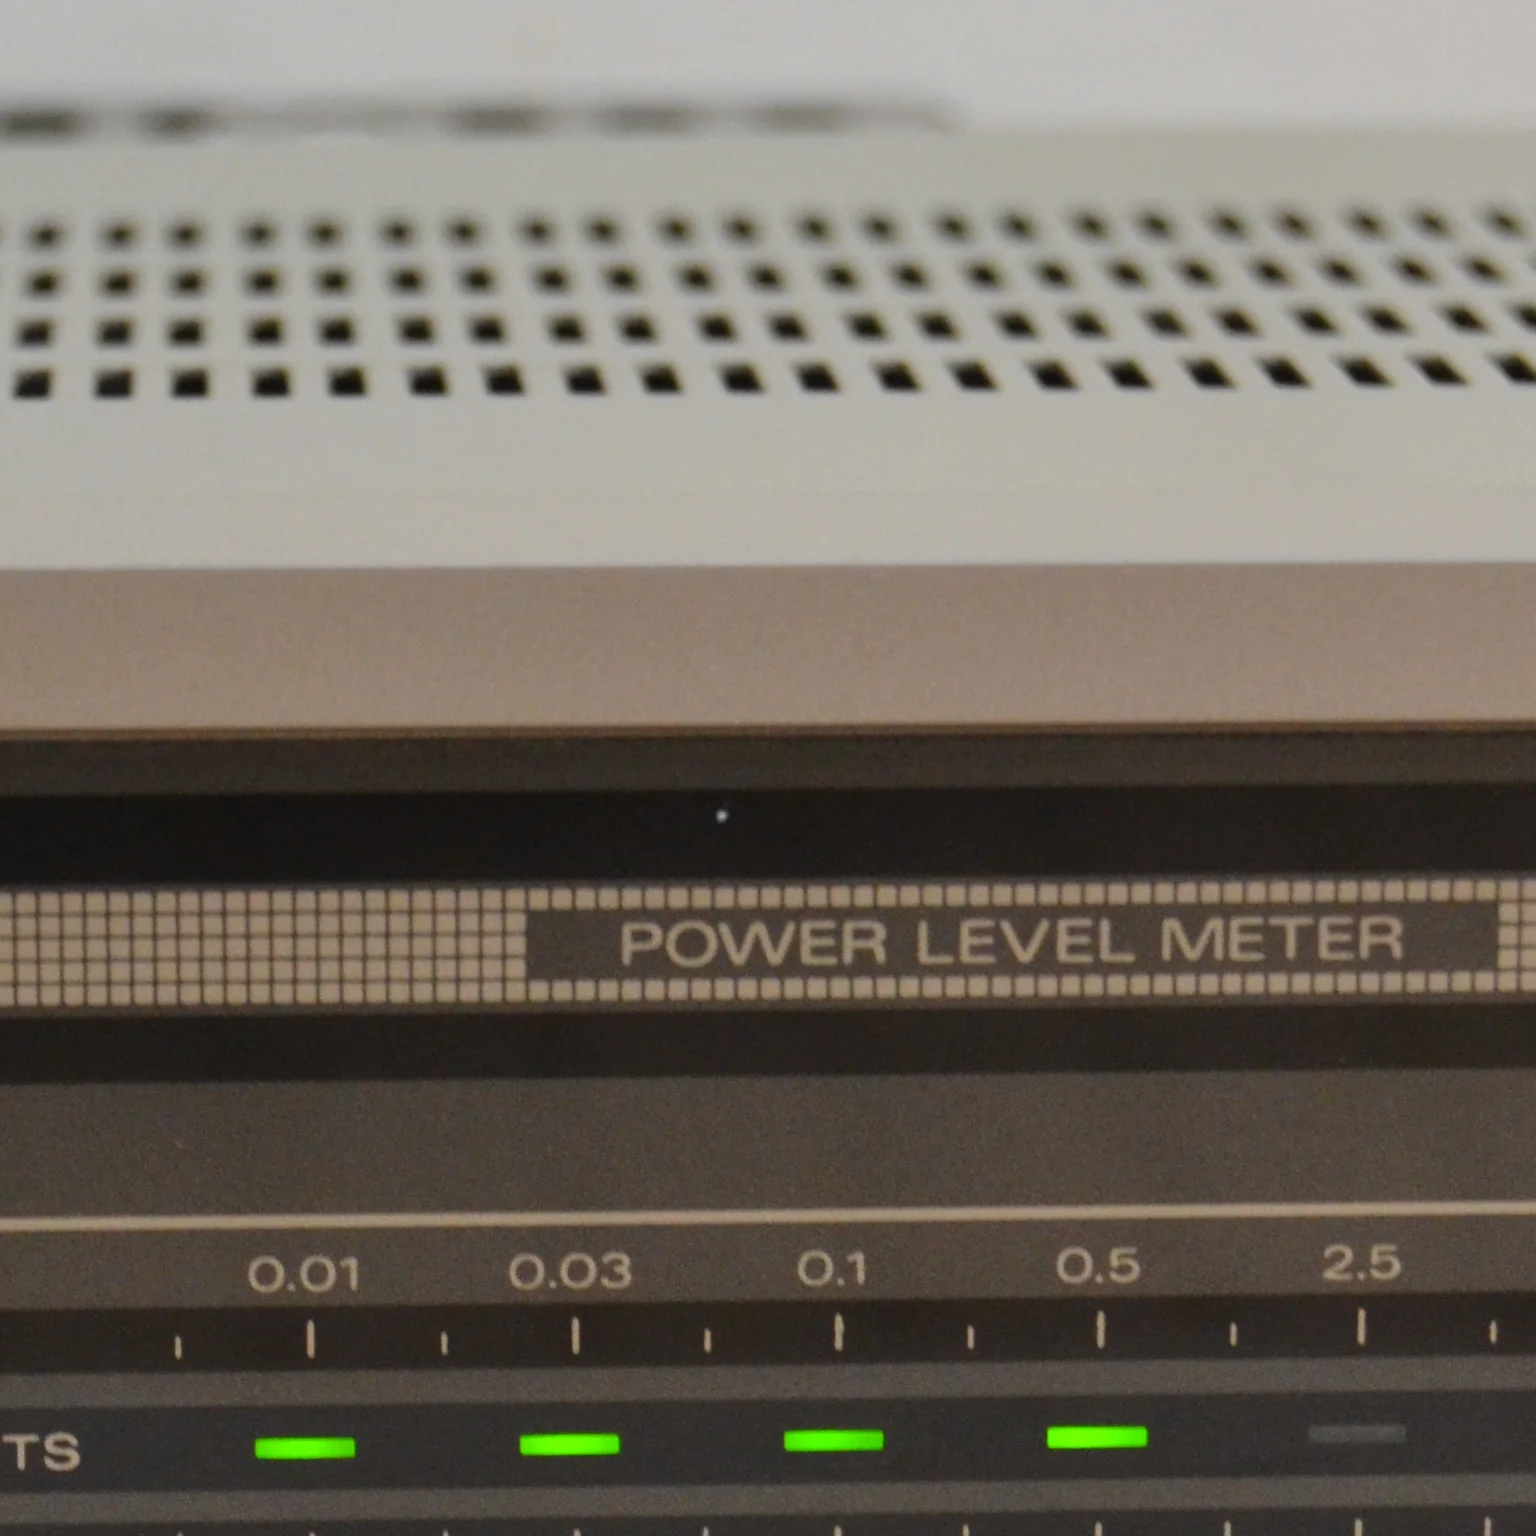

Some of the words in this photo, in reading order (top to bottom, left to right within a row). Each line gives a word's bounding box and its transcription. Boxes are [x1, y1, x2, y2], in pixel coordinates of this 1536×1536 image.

[622, 920, 887, 967] POWER
[917, 917, 1136, 965] LEVEL
[1161, 915, 1403, 961] METER
[248, 1255, 358, 1293] 0.01
[508, 1251, 632, 1290] 0.03
[797, 1249, 866, 1287] 0.1
[1056, 1247, 1141, 1284] 0.5
[1322, 1244, 1402, 1281] 2.5
